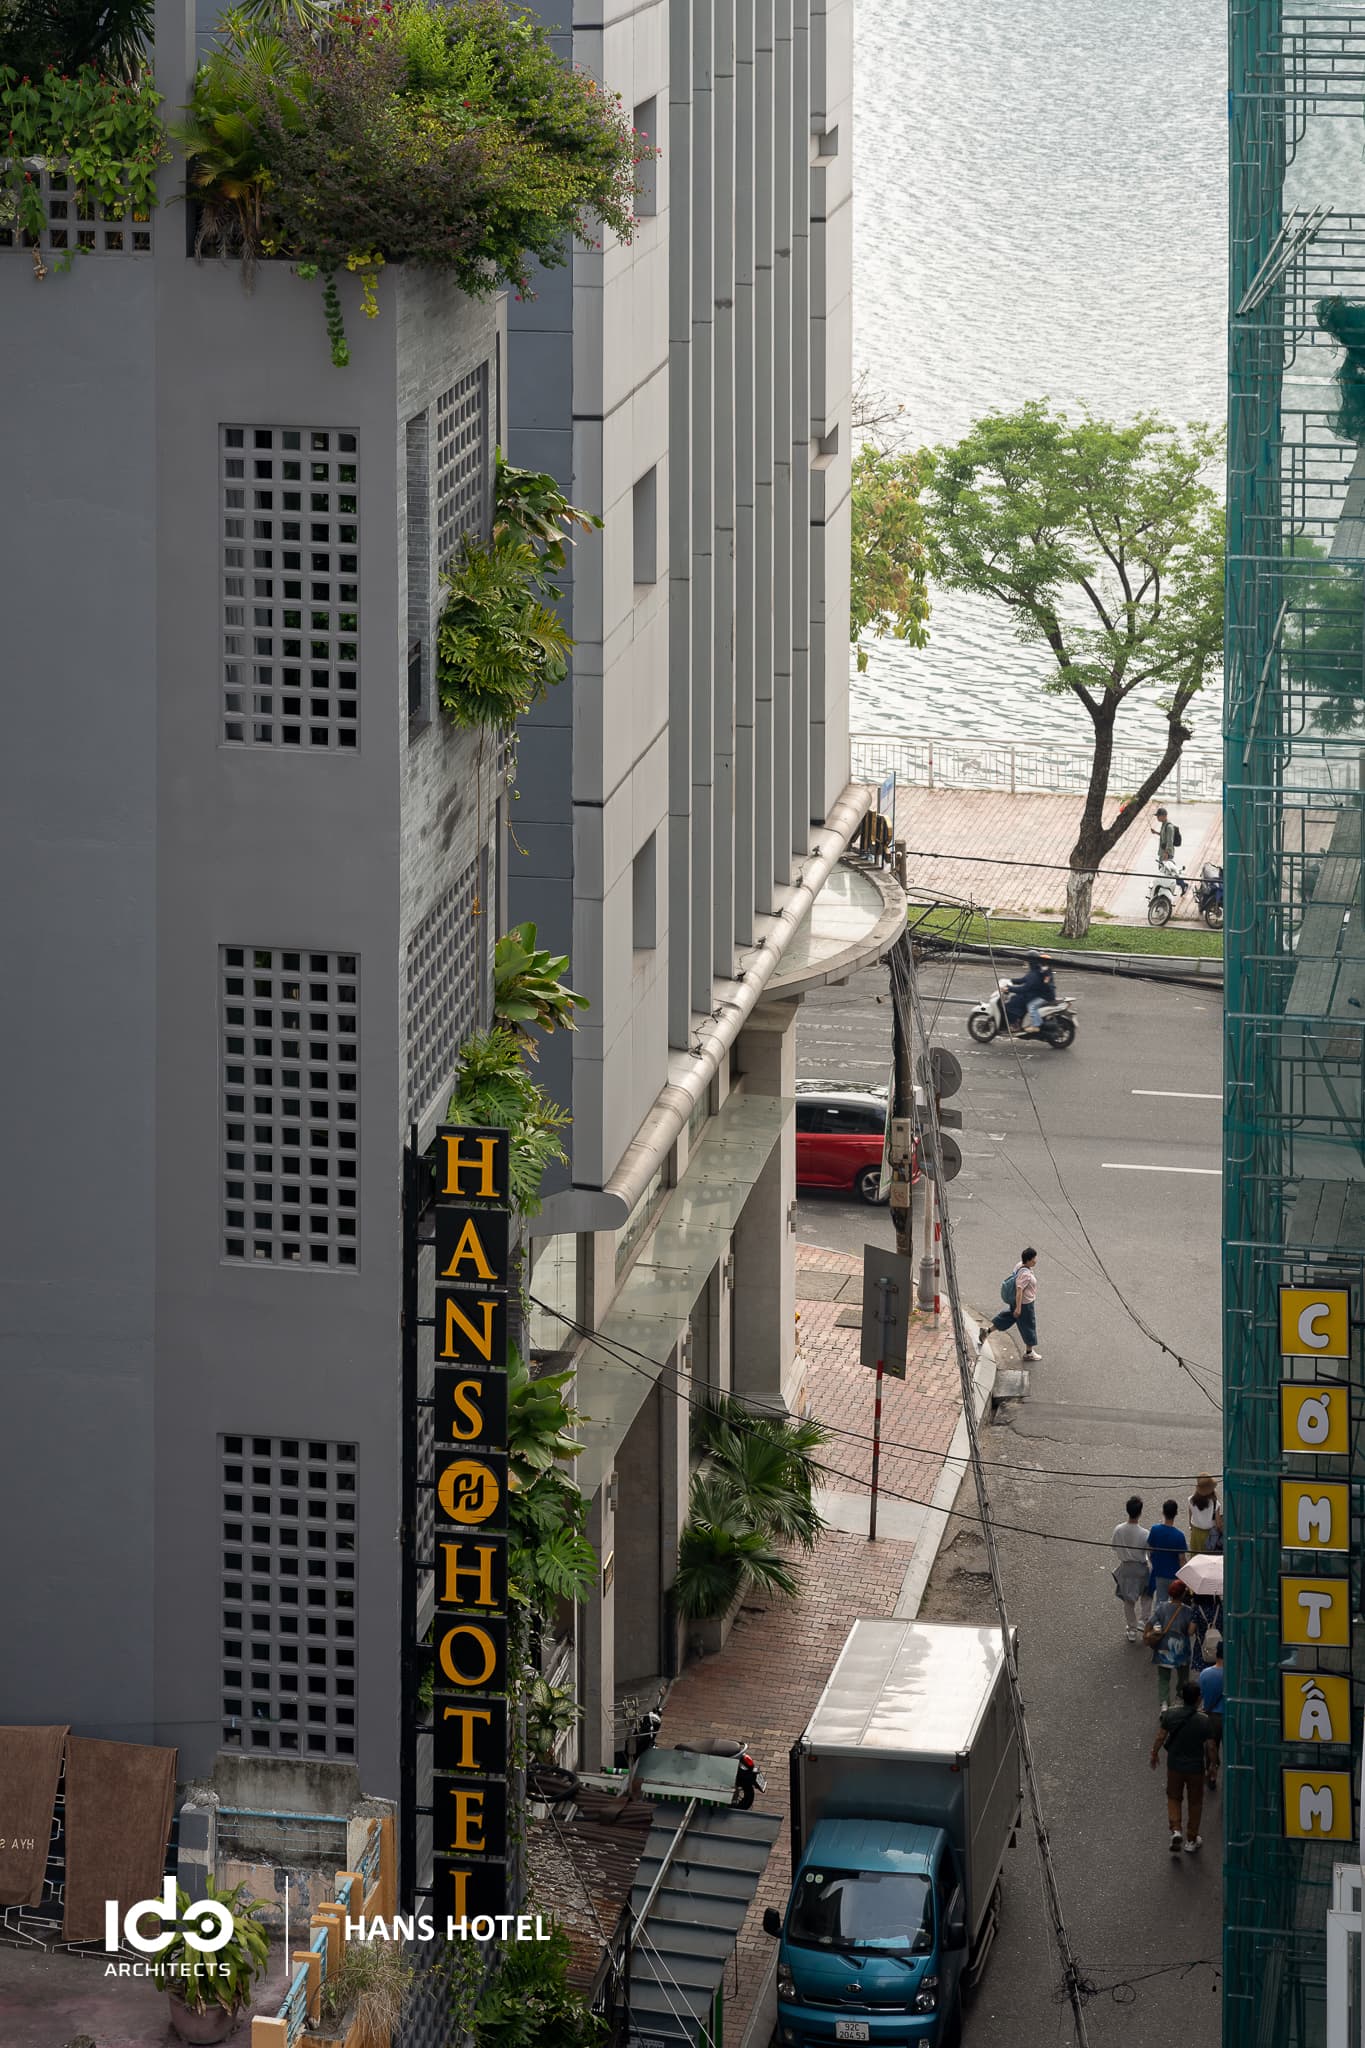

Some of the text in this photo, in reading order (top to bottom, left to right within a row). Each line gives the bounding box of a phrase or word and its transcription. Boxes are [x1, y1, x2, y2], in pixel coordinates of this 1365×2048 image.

[440, 1135, 500, 1441] HANS
[440, 1543, 500, 1932] HOTEL
[844, 2023, 860, 2032] 92C
